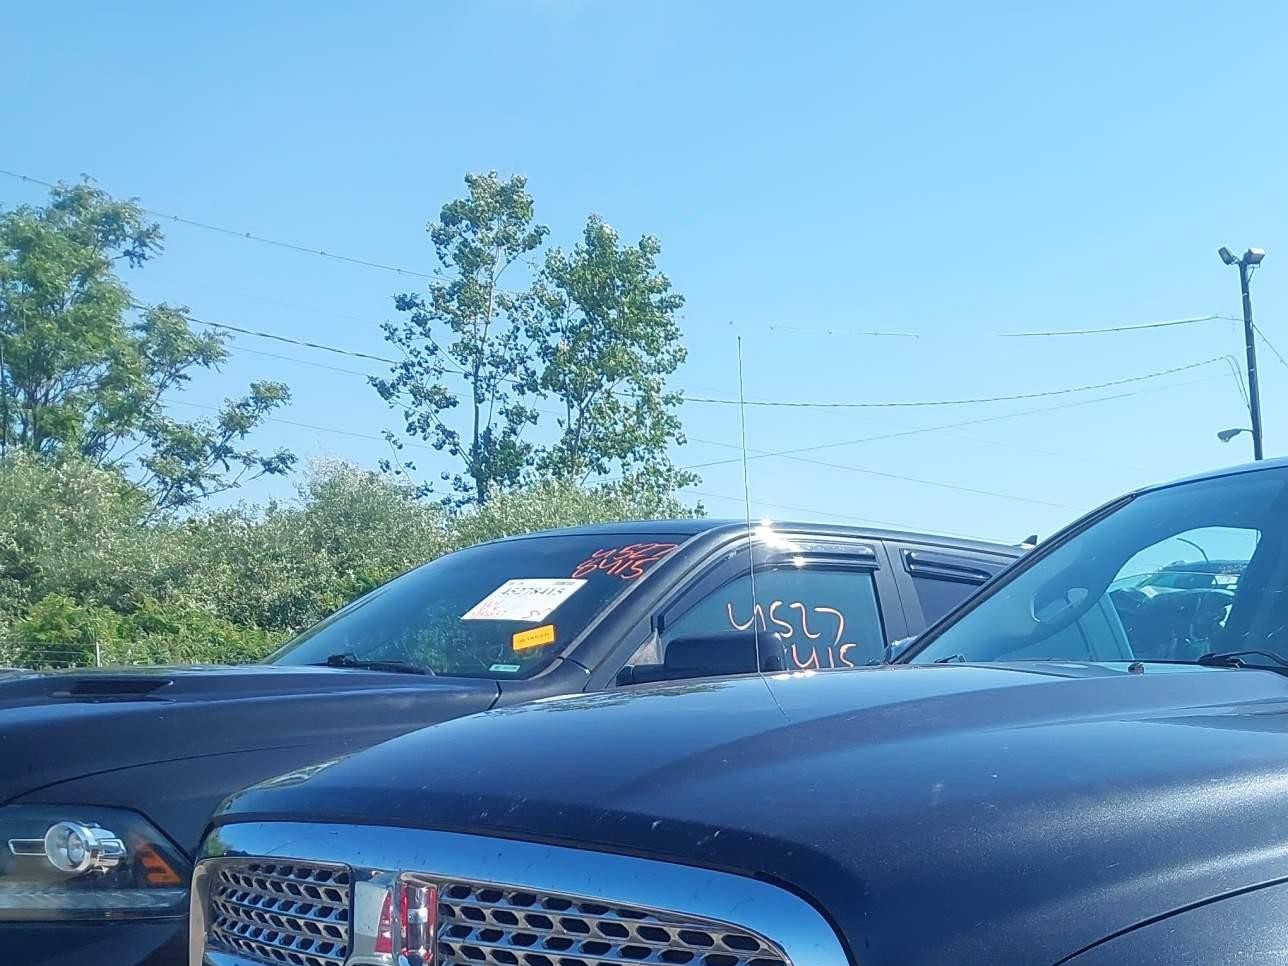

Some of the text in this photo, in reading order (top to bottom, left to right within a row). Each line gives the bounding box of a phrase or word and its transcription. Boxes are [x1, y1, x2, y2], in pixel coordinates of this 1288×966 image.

[592, 543, 679, 560] 4527
[727, 601, 845, 647] 4527
[791, 643, 857, 669] 415
